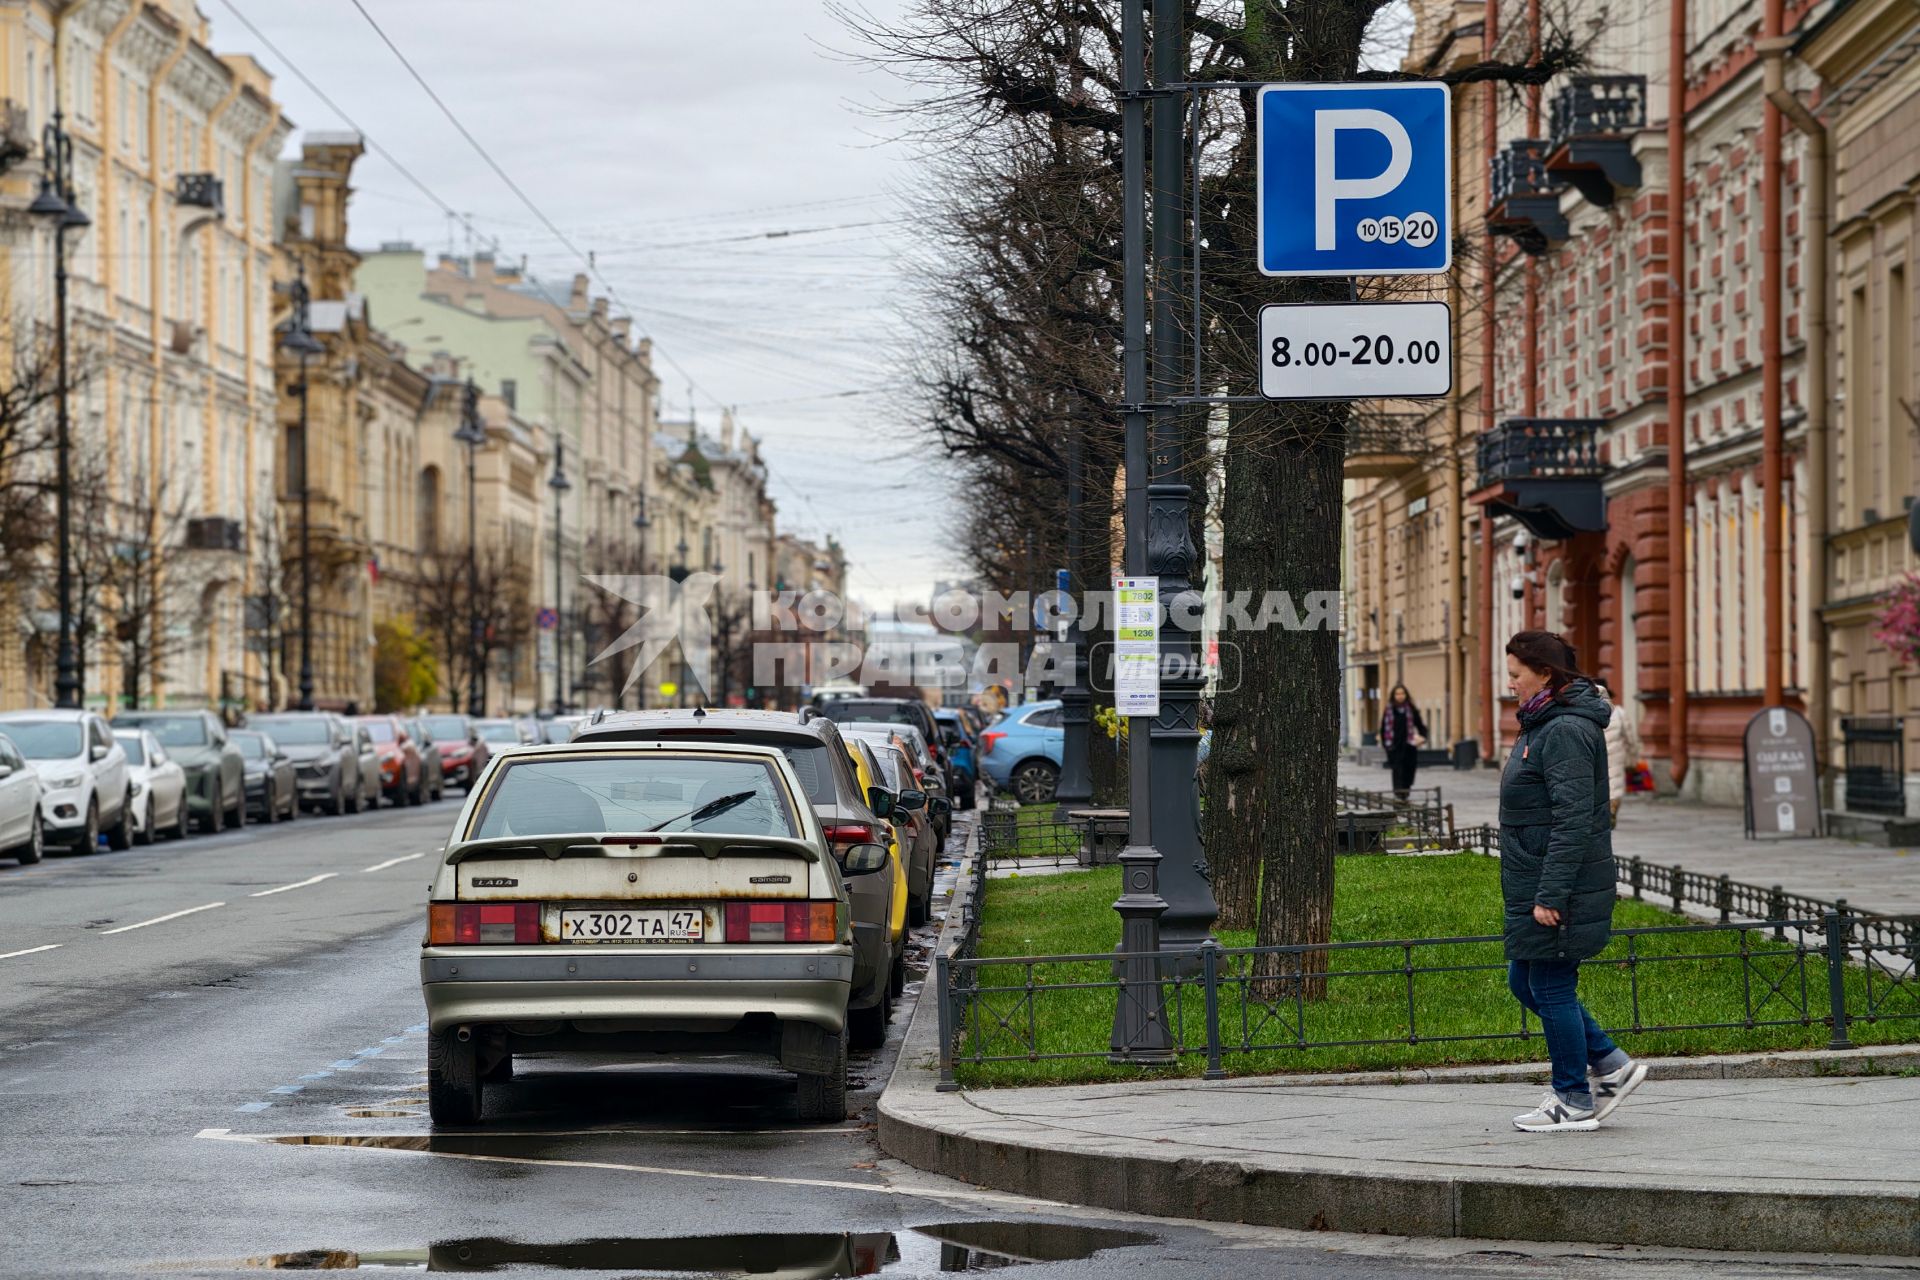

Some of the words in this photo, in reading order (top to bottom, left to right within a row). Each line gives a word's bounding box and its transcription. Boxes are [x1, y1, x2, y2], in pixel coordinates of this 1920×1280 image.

[1315, 108, 1413, 251] P
[1361, 223, 1376, 235] 10
[1382, 221, 1400, 238] 15
[1406, 220, 1435, 240] 20
[1271, 334, 1440, 367] 8.00-20.00
[1156, 455, 1169, 465] 53
[1132, 592, 1153, 601] 7802
[1132, 629, 1154, 638] 1236
[671, 912, 694, 930] 47
[670, 929, 687, 937] RUS
